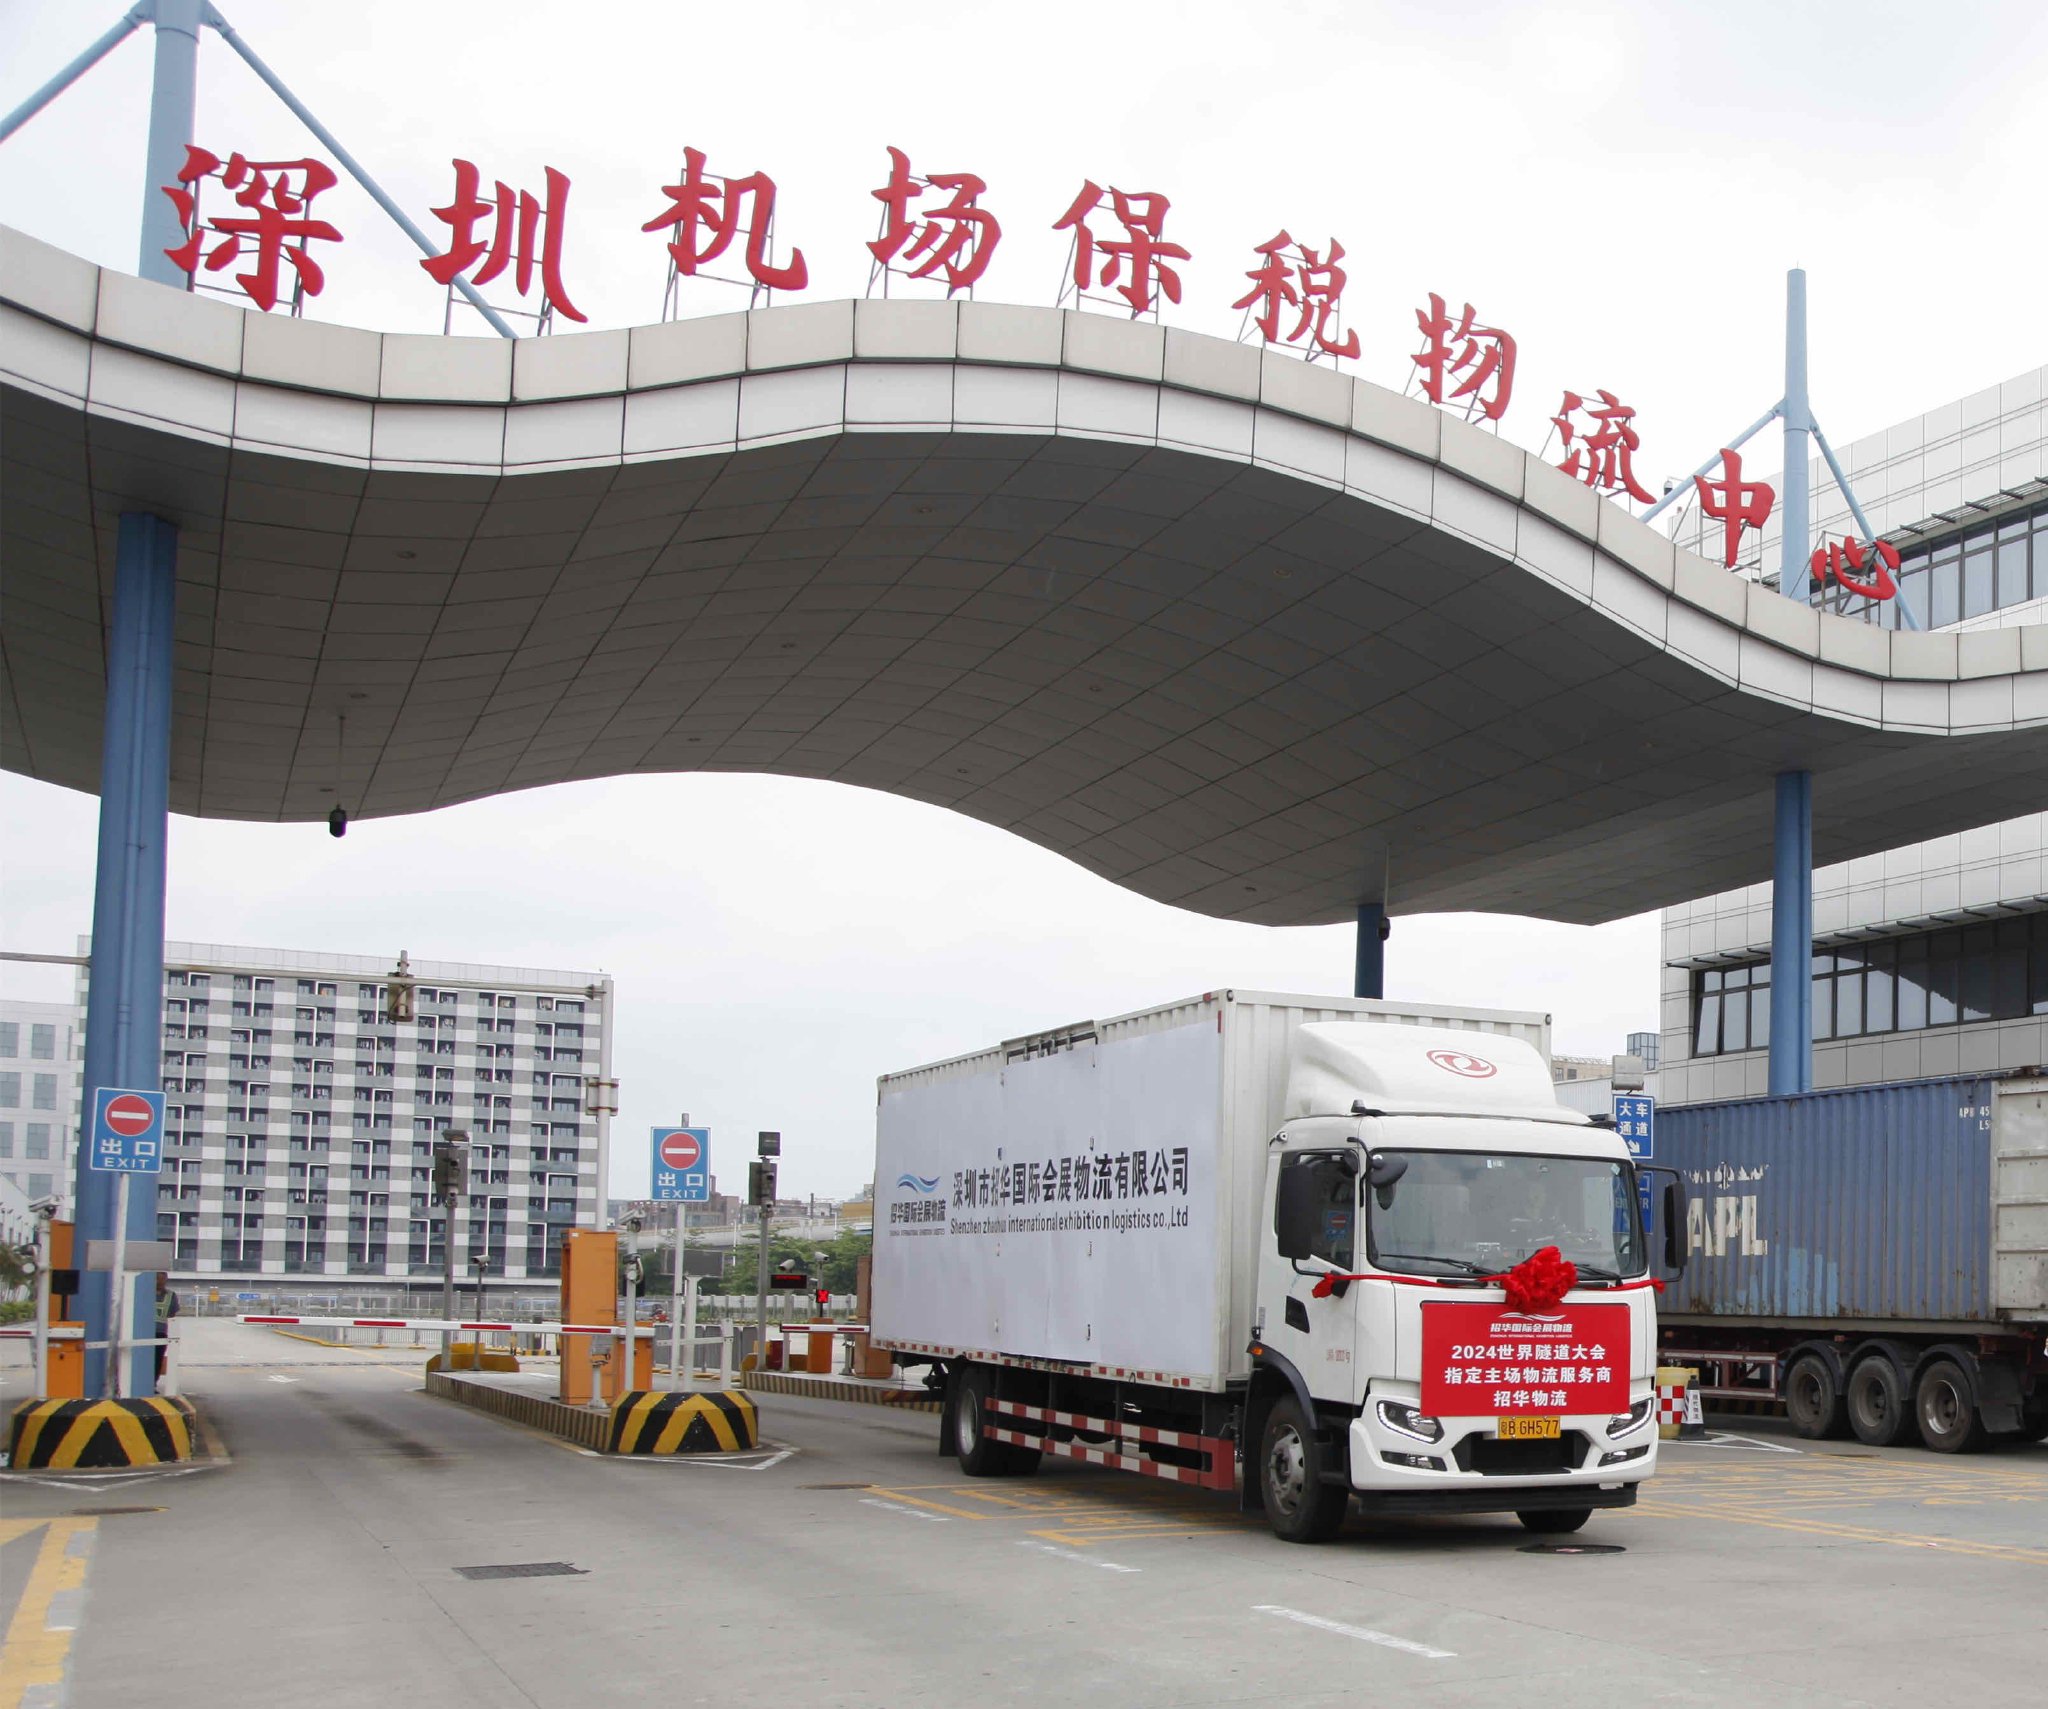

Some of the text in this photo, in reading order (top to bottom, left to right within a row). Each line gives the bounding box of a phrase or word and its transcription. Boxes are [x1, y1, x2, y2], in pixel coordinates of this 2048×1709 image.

[160, 145, 1901, 600] 深圳机场保税物流中心
[1619, 1101, 1649, 1118] 大车
[1619, 1121, 1649, 1137] 通道
[101, 1138, 156, 1157] 出口
[104, 1157, 150, 1169] EXIT
[658, 1172, 704, 1187] 出口
[662, 1189, 698, 1199] EXIT
[1008, 1211, 1058, 1233] international
[1060, 1210, 1110, 1231] exhibition
[1112, 1208, 1151, 1234] logistics
[1686, 1195, 1768, 1257] APL
[1451, 1343, 1606, 1361] 2024世界隧道大会
[1445, 1366, 1612, 1385] 指定主场物流服务商
[1493, 1390, 1567, 1407] 招华物流
